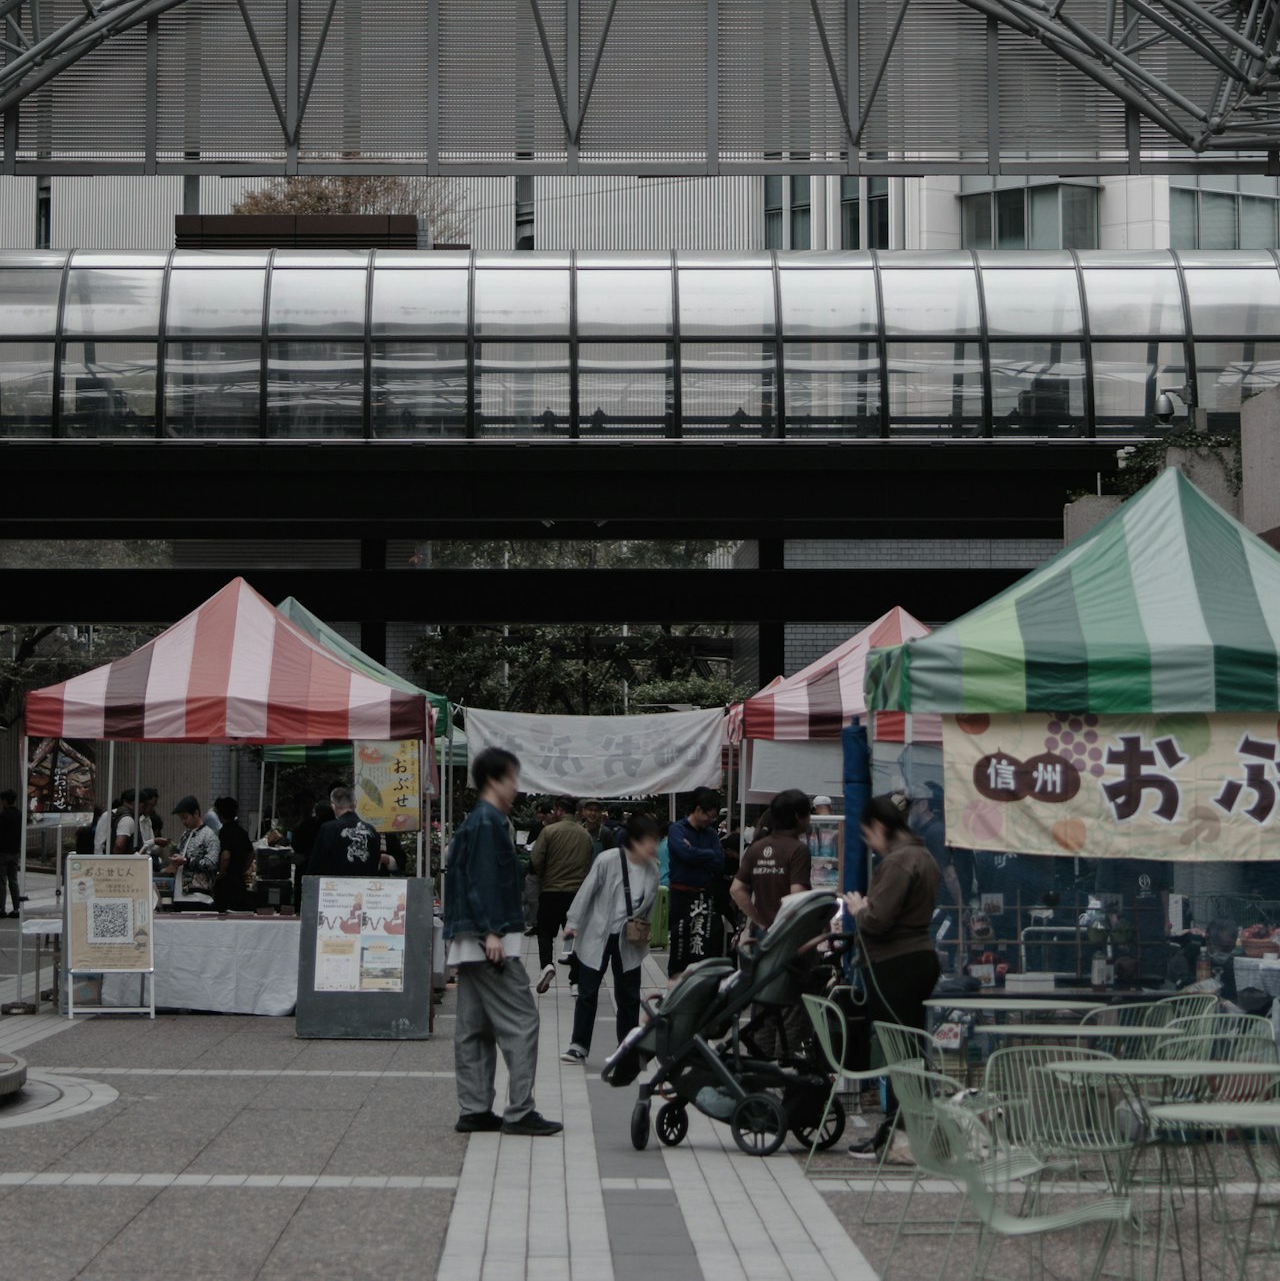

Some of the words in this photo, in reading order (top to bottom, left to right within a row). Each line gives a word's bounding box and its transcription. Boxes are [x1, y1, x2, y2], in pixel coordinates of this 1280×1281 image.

[393, 758, 409, 807] おぶせ
[985, 757, 1064, 796] 信州
[84, 866, 134, 878] おぶせじん
